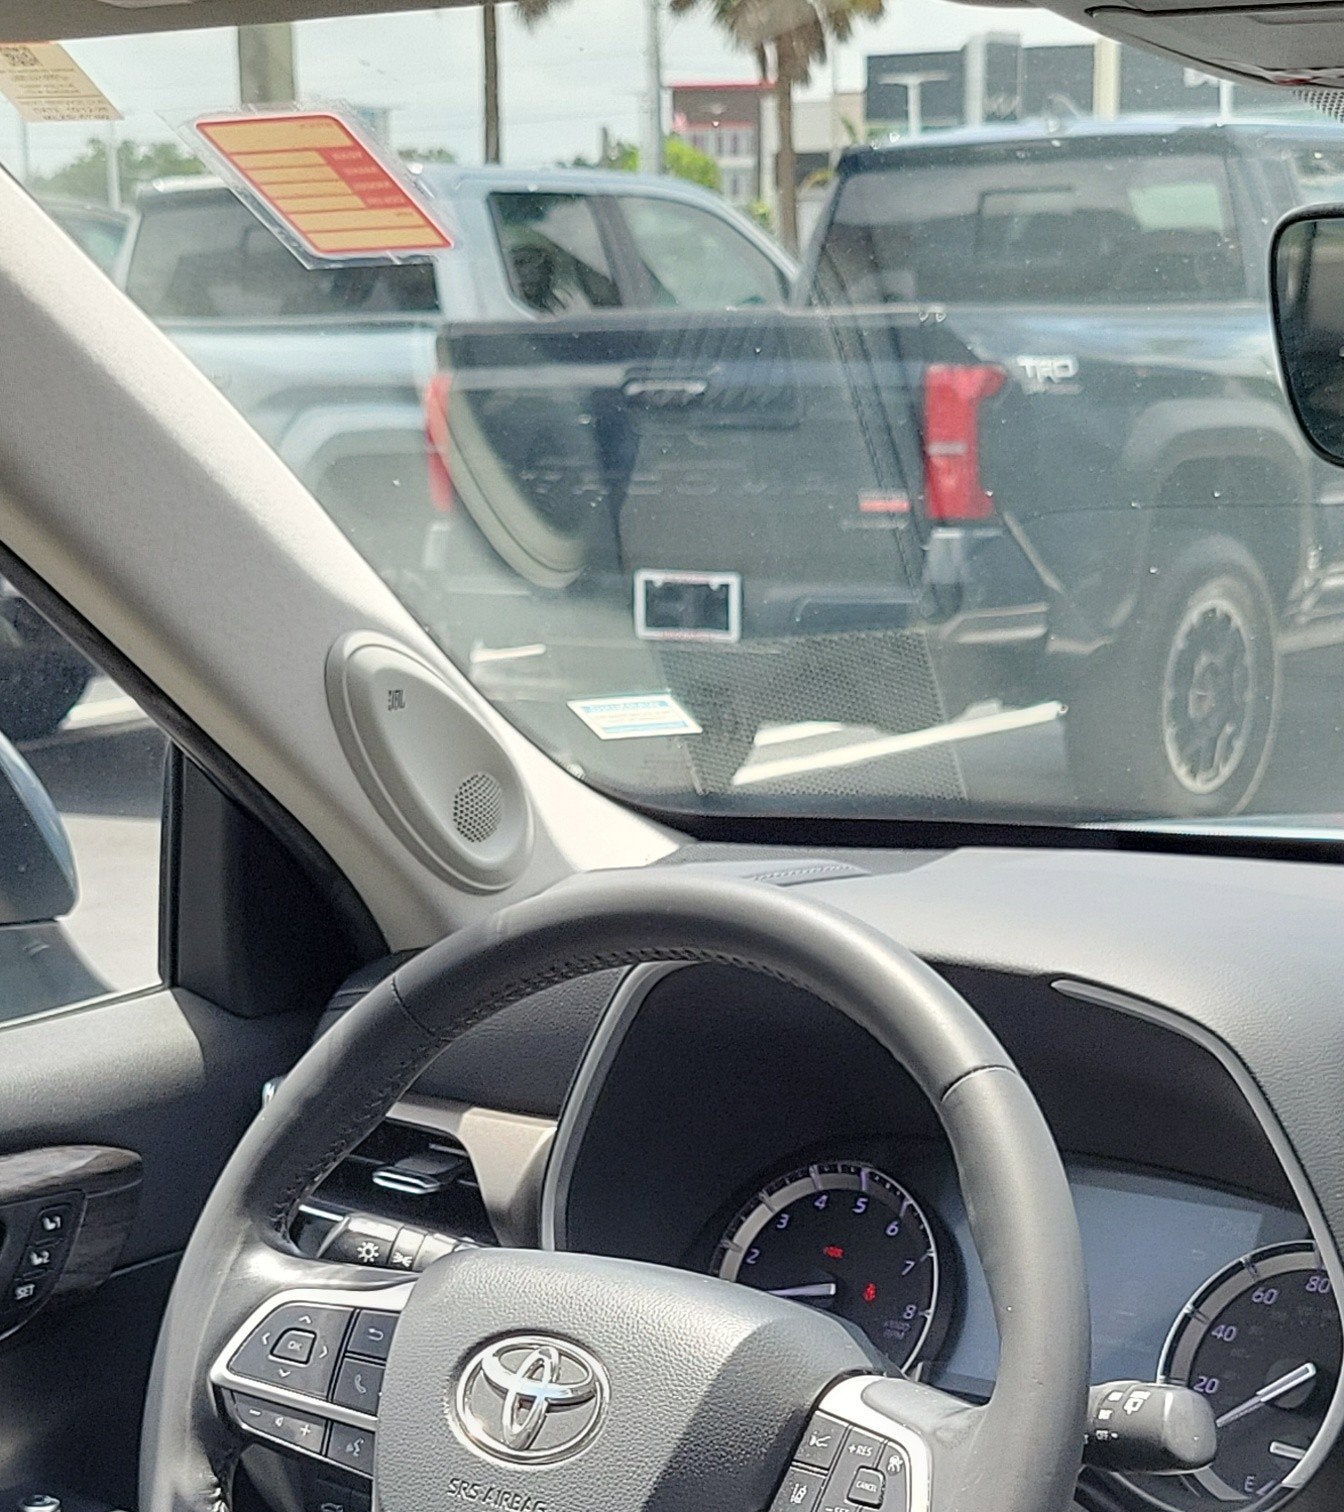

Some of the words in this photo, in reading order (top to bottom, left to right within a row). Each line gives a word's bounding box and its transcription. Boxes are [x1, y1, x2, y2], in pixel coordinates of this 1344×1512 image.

[1017, 355, 1076, 383] TRD
[812, 1193, 829, 1210] 4
[852, 1197, 869, 1214] 5
[775, 1212, 791, 1229] 3
[884, 1219, 900, 1237] 6
[745, 1249, 760, 1265] 2
[901, 1260, 916, 1276] 7
[1305, 1275, 1332, 1295] 80
[1251, 1287, 1278, 1306] 60
[902, 1304, 918, 1321] 8
[1210, 1323, 1238, 1343] 40
[287, 1340, 303, 1352] OK
[1192, 1374, 1220, 1395] 20
[447, 1476, 481, 1501] SRS
[855, 1479, 879, 1494] CANCEL
[1244, 1475, 1257, 1493] E
